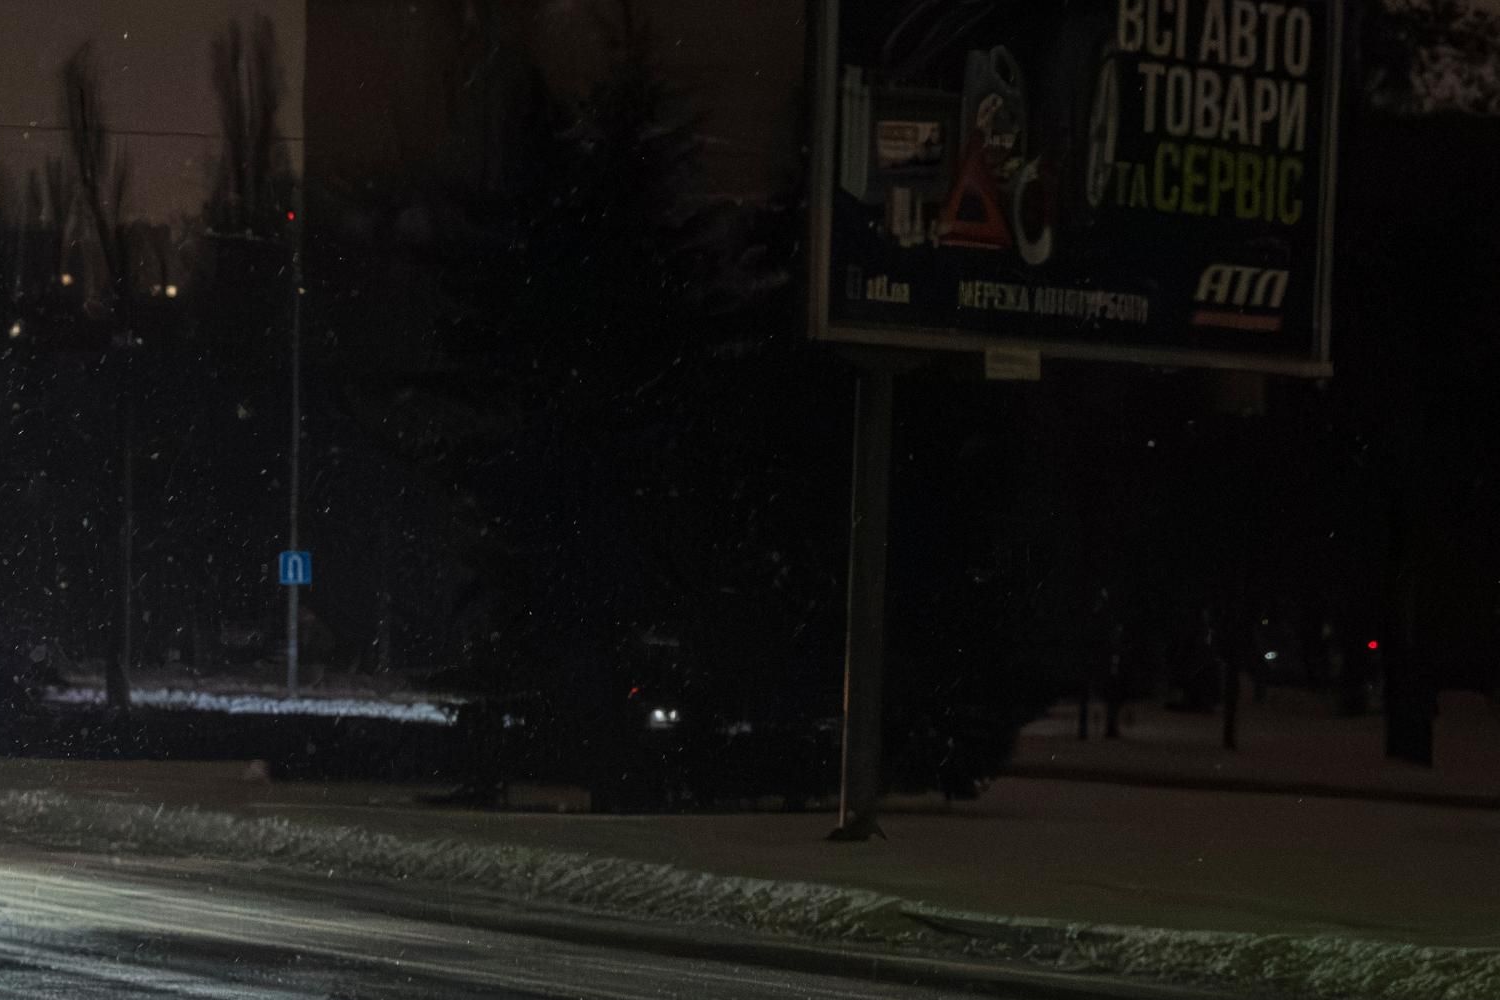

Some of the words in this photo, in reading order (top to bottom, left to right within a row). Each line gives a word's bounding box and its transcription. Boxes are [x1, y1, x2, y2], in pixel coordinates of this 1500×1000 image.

[1117, 0, 1188, 60] ВСІ
[1199, 0, 1312, 78] АВТО
[1137, 62, 1308, 150] ТОВАРИ
[1114, 160, 1149, 208] ТА
[1153, 141, 1303, 225] СЕРВІС
